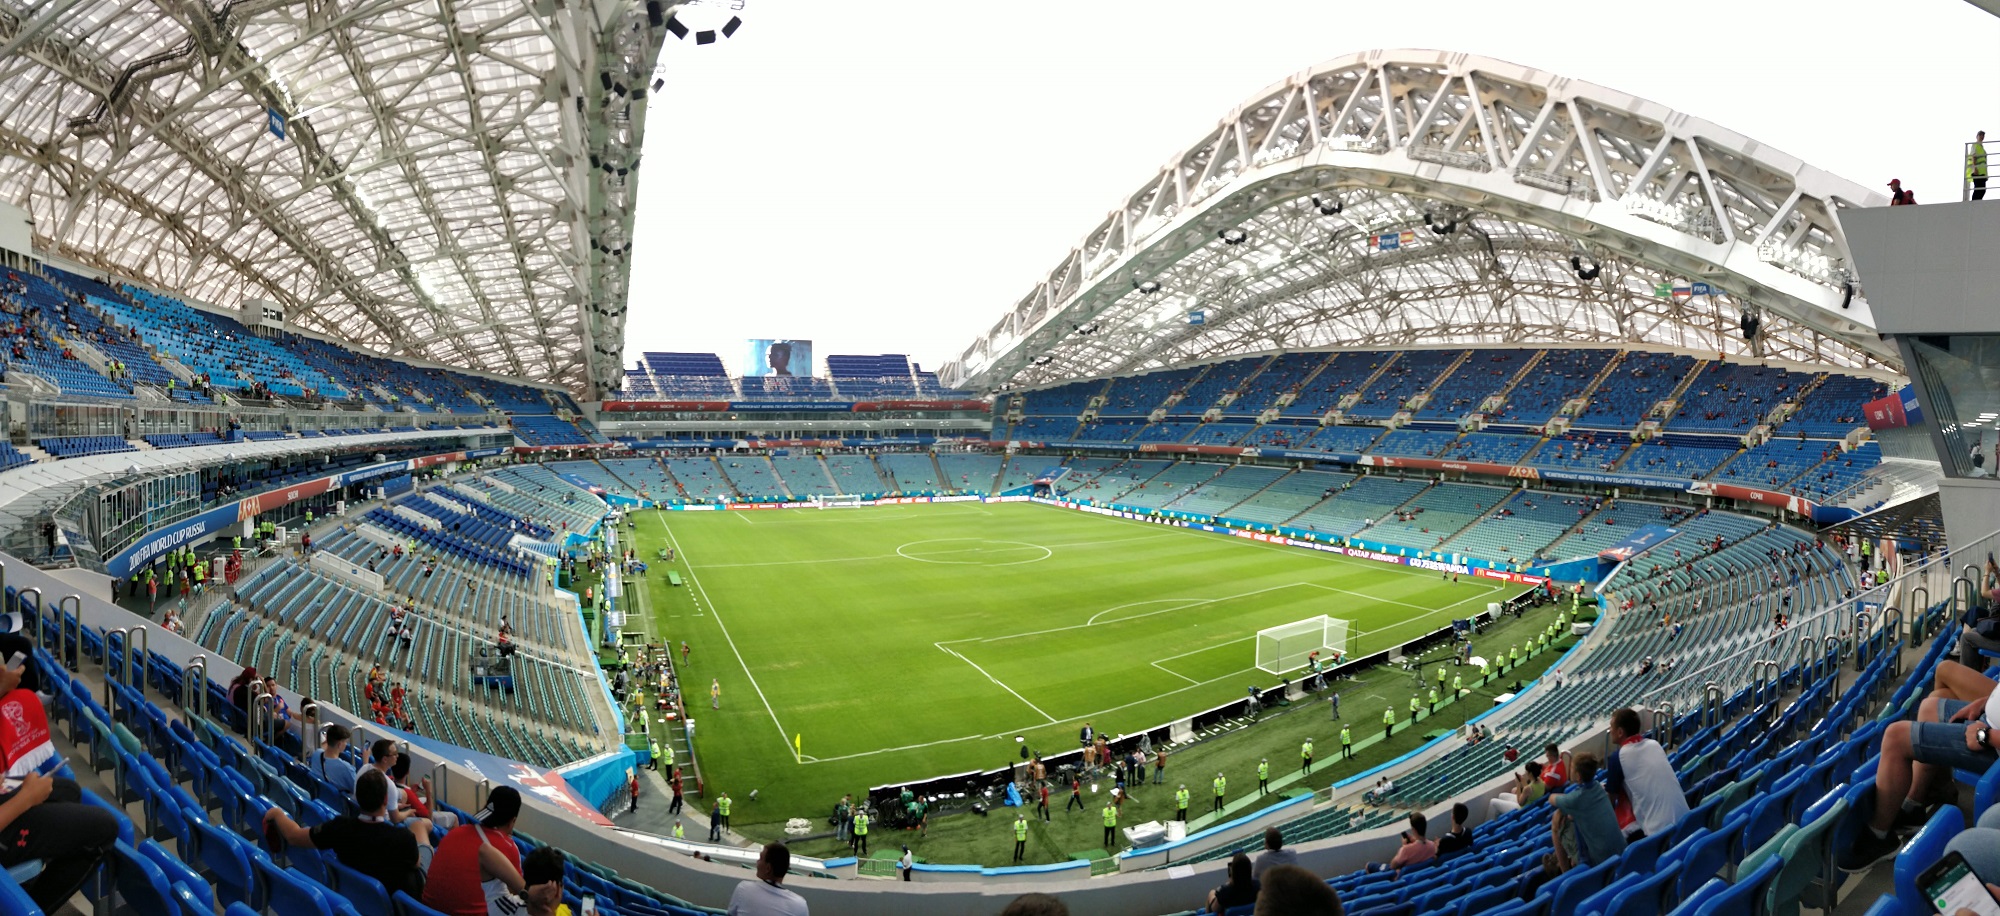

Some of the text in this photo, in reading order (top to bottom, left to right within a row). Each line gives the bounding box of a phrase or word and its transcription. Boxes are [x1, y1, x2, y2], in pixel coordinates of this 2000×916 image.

[287, 490, 299, 501] SOCHI
[1750, 491, 1763, 501] СОЧИ
[129, 521, 206, 571] 2018 FIFA WORLD CUP RUSSIA
[1348, 549, 1399, 563] QATAR AIRWAYS
